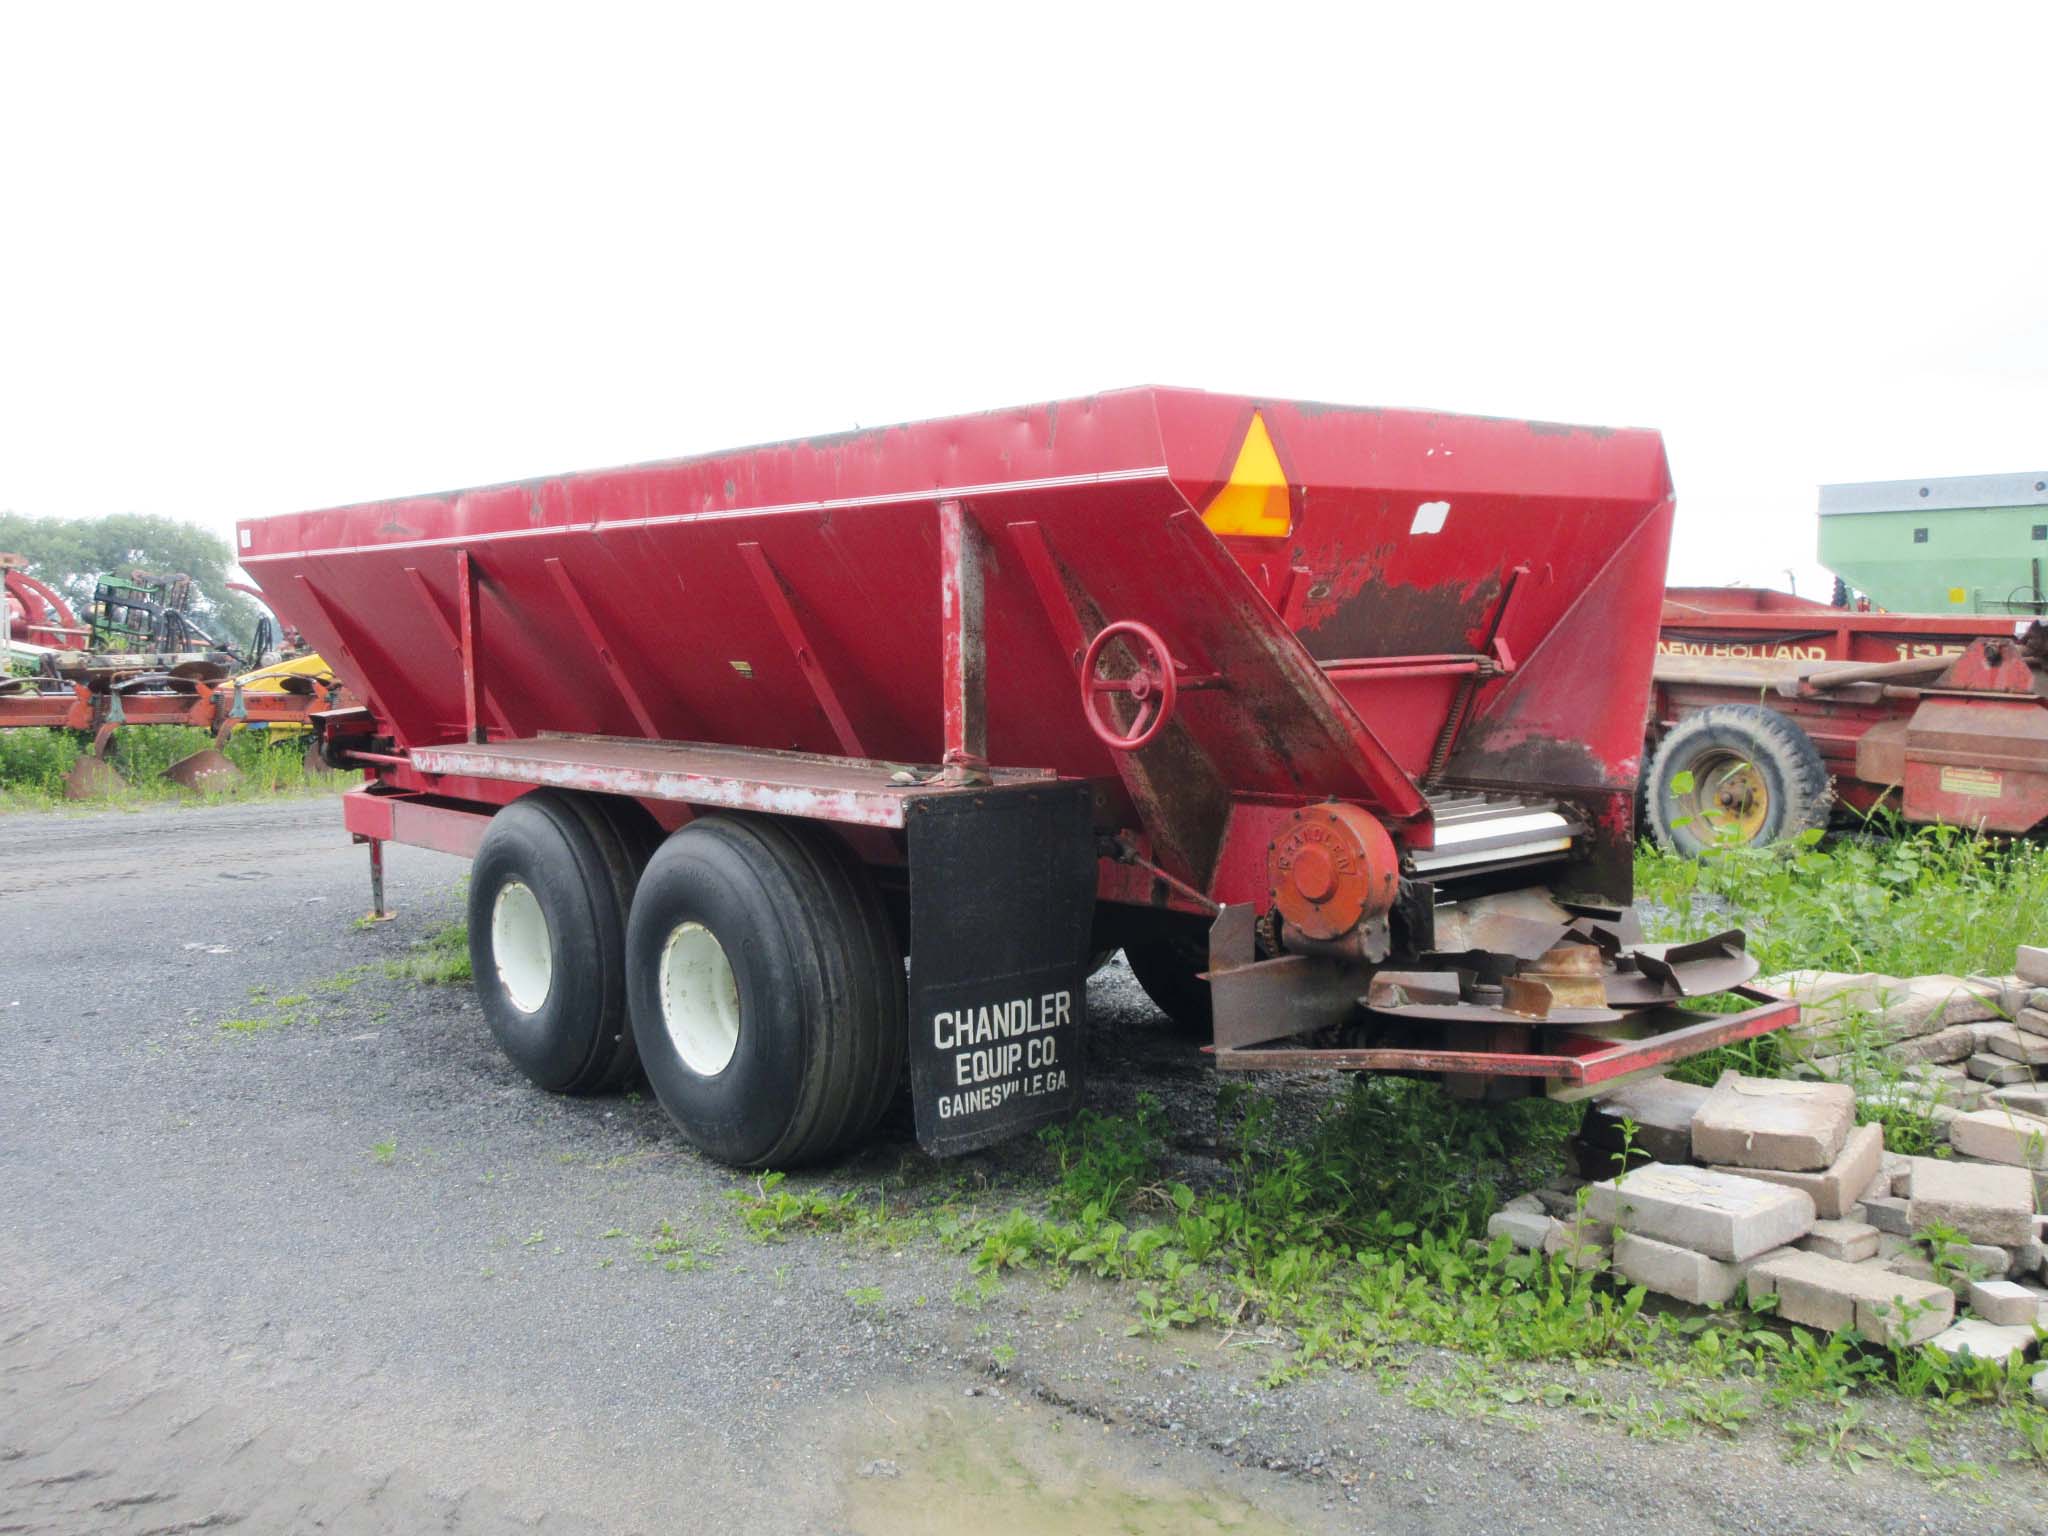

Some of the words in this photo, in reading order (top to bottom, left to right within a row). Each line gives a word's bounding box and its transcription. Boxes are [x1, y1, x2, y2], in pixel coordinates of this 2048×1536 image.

[1656, 641, 1706, 656] NEW
[1712, 644, 1827, 661] HOLLAND
[934, 991, 1070, 1049] CHANDLER
[956, 1043, 1022, 1086] EQUIP.
[1027, 1036, 1059, 1069] CO.
